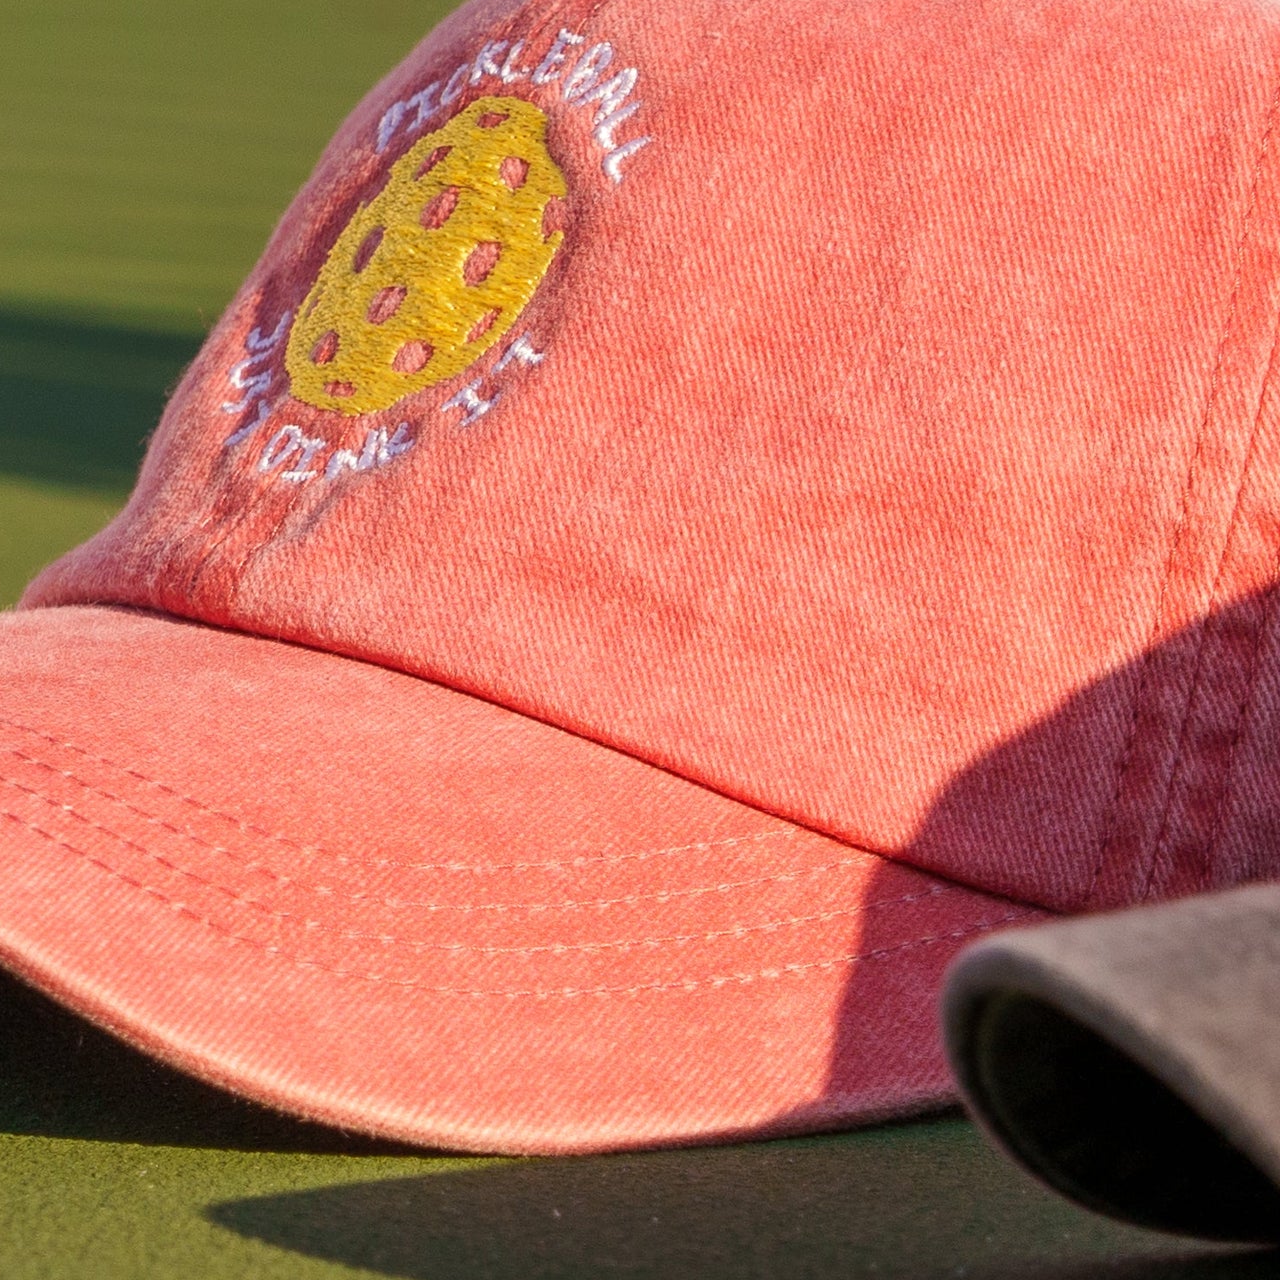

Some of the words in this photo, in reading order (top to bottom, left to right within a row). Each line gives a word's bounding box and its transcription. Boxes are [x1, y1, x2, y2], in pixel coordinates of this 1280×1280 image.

[375, 28, 653, 183] PICKLEBALL
[258, 424, 416, 483] DINK
[440, 332, 546, 426] IT
